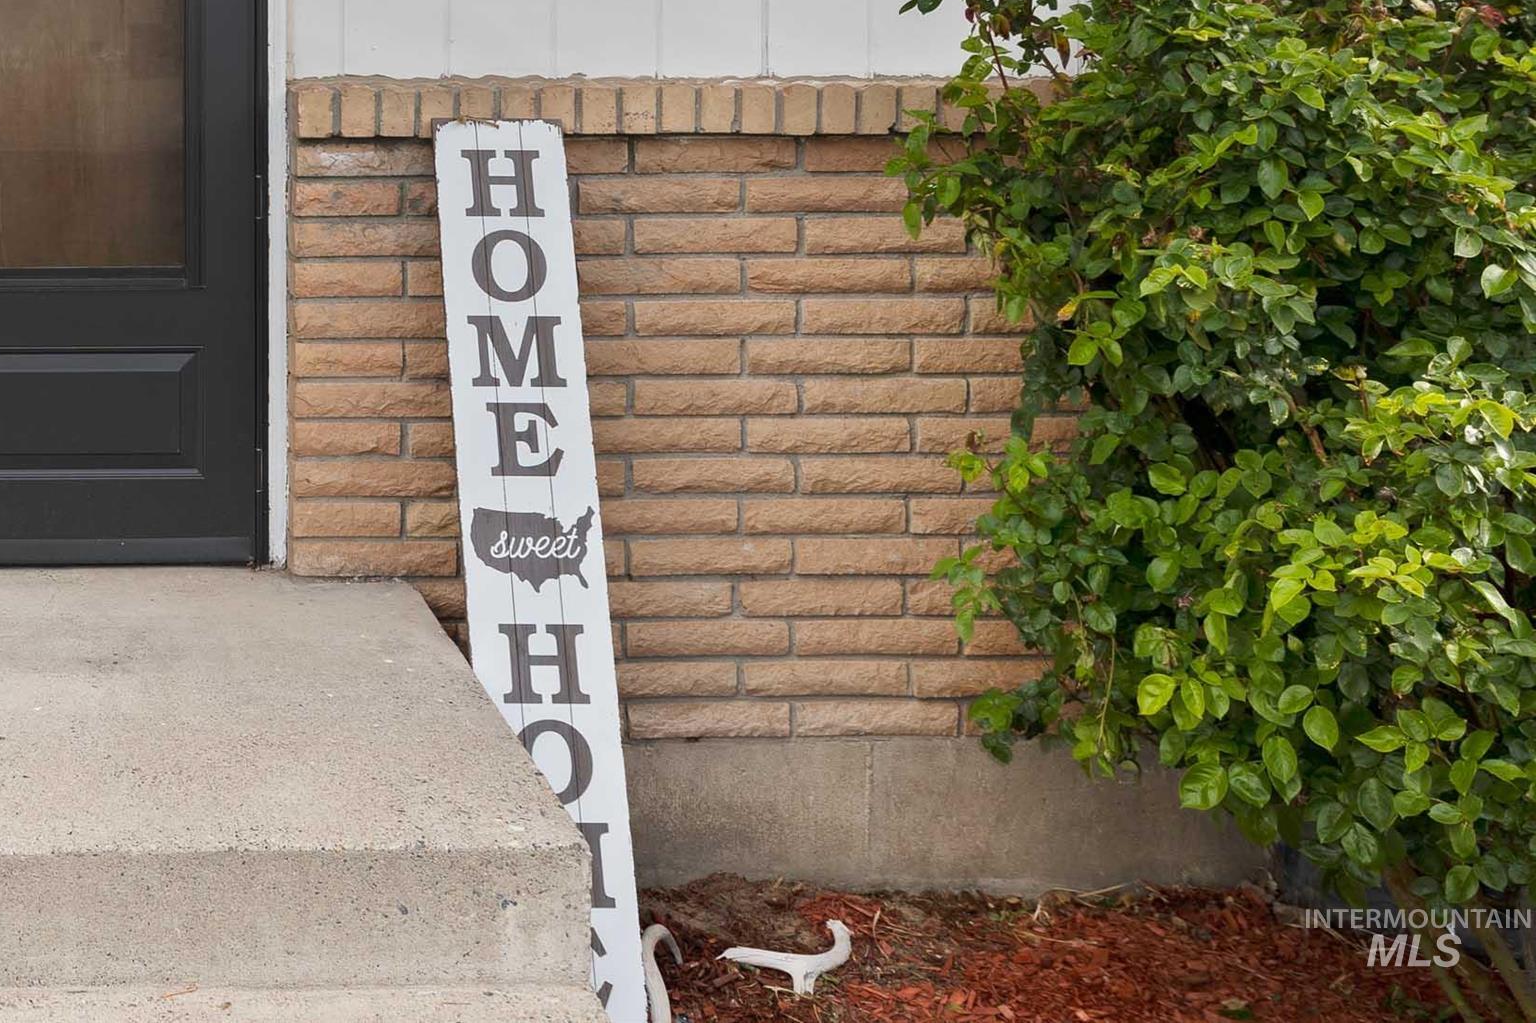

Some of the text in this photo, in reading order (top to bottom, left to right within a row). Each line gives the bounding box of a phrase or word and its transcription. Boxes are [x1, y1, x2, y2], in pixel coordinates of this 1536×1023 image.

[461, 149, 567, 476] HOME
[490, 528, 582, 559] sweet
[498, 624, 616, 1010] HO
